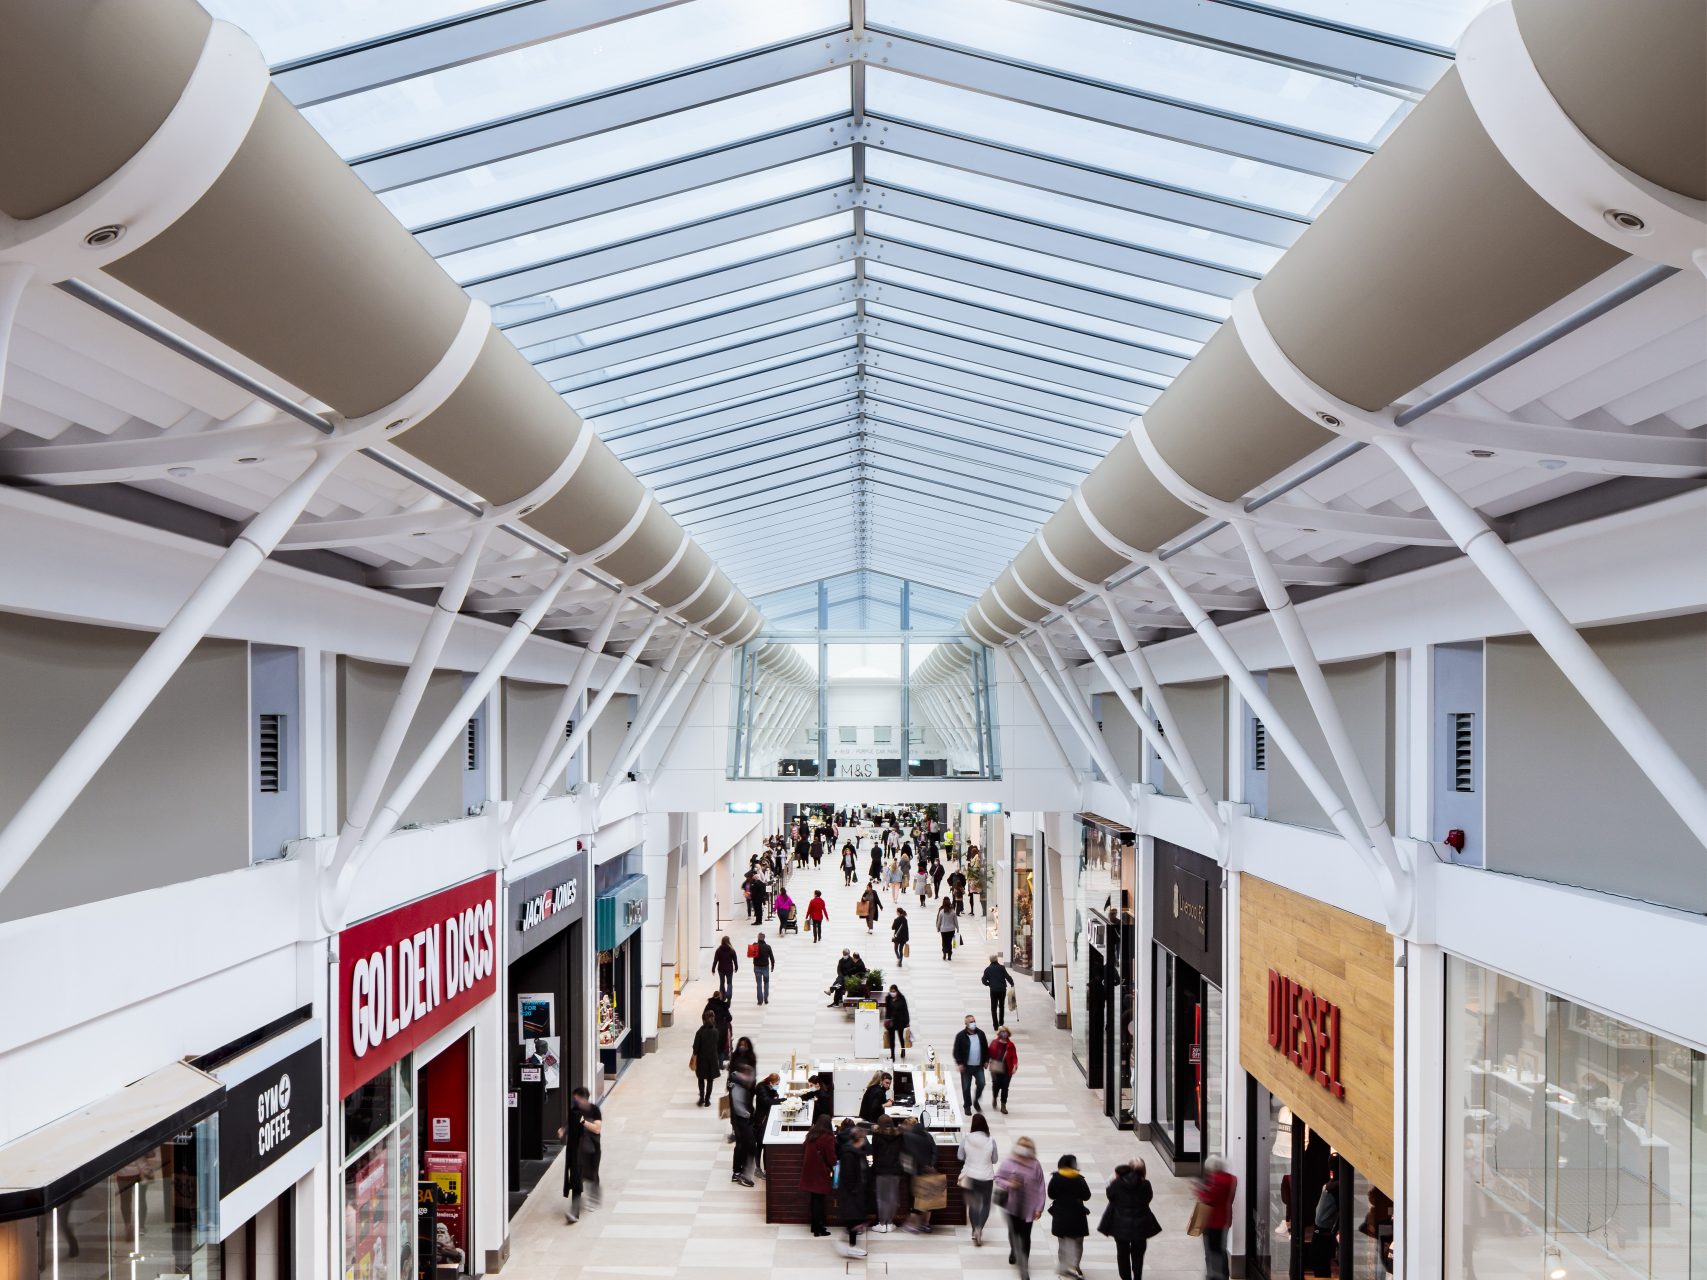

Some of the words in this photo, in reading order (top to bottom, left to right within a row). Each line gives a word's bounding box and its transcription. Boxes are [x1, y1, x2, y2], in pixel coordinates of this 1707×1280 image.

[841, 763, 873, 777] M&S
[522, 894, 546, 932] JACK
[552, 878, 577, 914] JONES
[352, 923, 440, 1058] GOLDEN
[445, 899, 493, 1000] DISCS
[1267, 967, 1345, 1102] DIESEL
[258, 1108, 291, 1156] COFFEE
